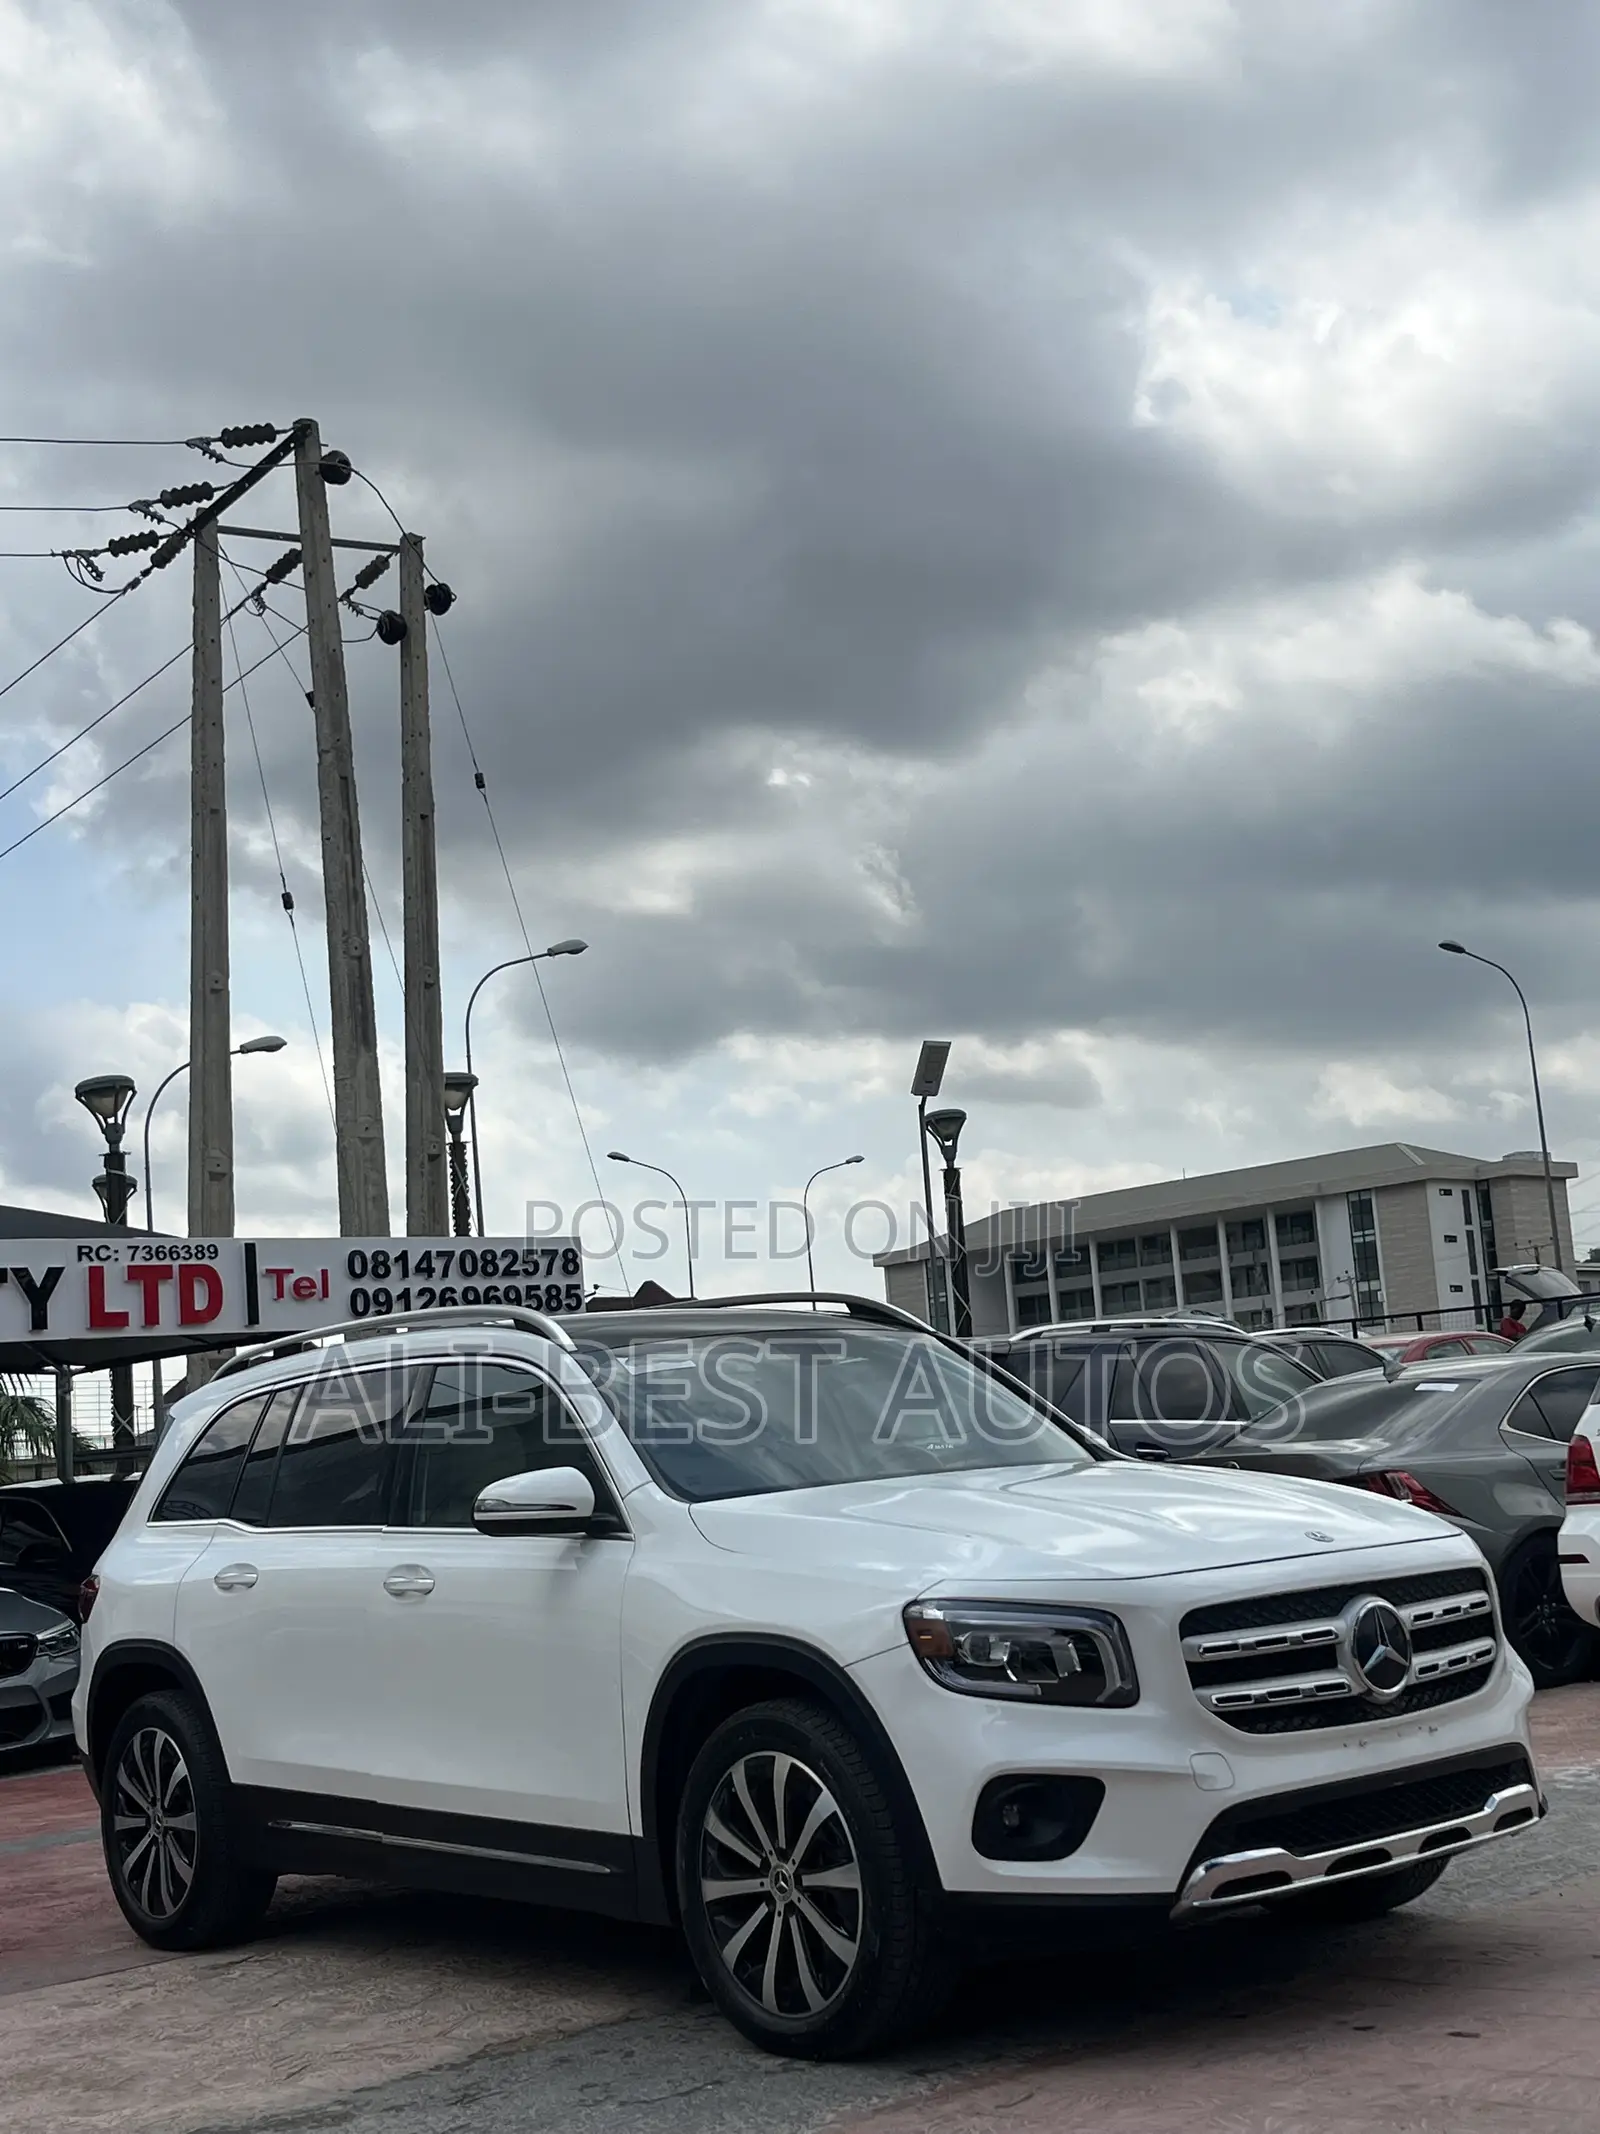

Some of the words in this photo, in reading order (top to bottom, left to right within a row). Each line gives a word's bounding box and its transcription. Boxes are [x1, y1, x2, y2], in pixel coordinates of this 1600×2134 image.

[77, 1245, 119, 1262] RC:
[127, 1244, 219, 1261] 7366389
[348, 1249, 580, 1280] 08147082578
[0, 1266, 66, 1331] Y
[86, 1264, 224, 1329] LTD
[265, 1268, 330, 1301] Tel
[350, 1284, 583, 1317] 09126969585
